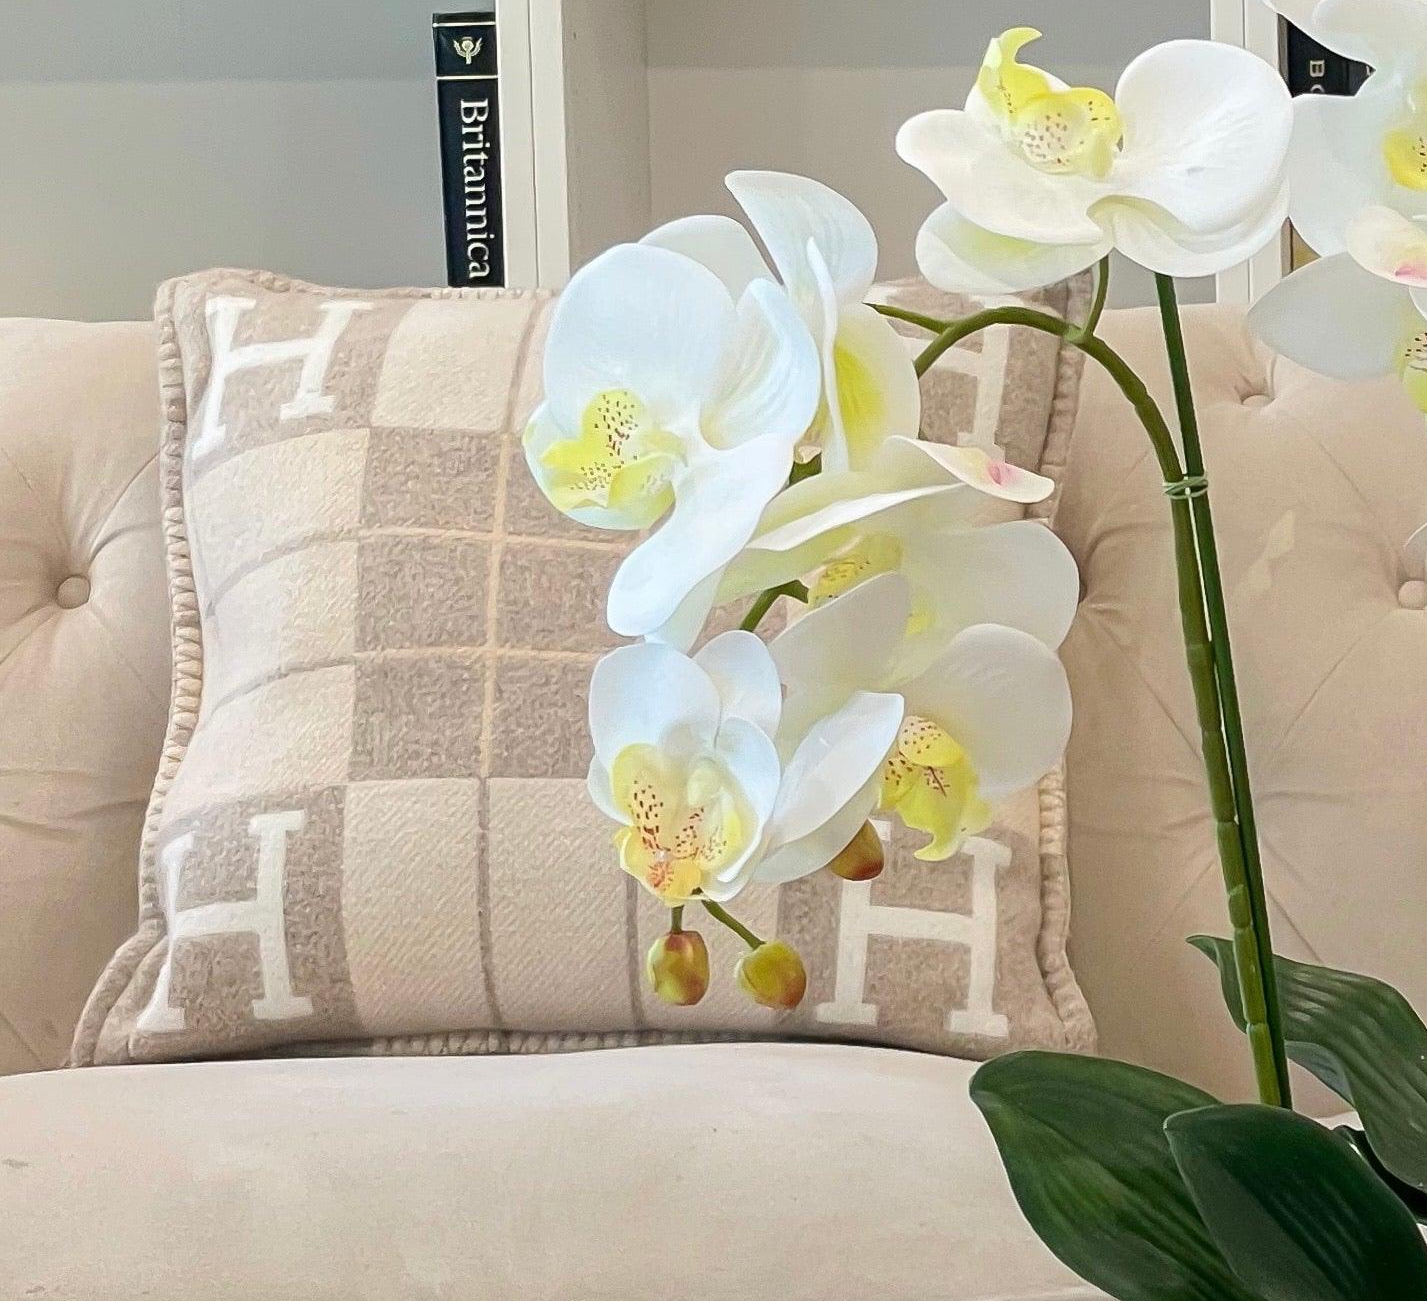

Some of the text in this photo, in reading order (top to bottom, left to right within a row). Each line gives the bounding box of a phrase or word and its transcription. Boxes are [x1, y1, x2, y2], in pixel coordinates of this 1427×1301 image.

[460, 98, 495, 280] Britannica
[193, 298, 374, 454] H
[136, 808, 314, 1034] H
